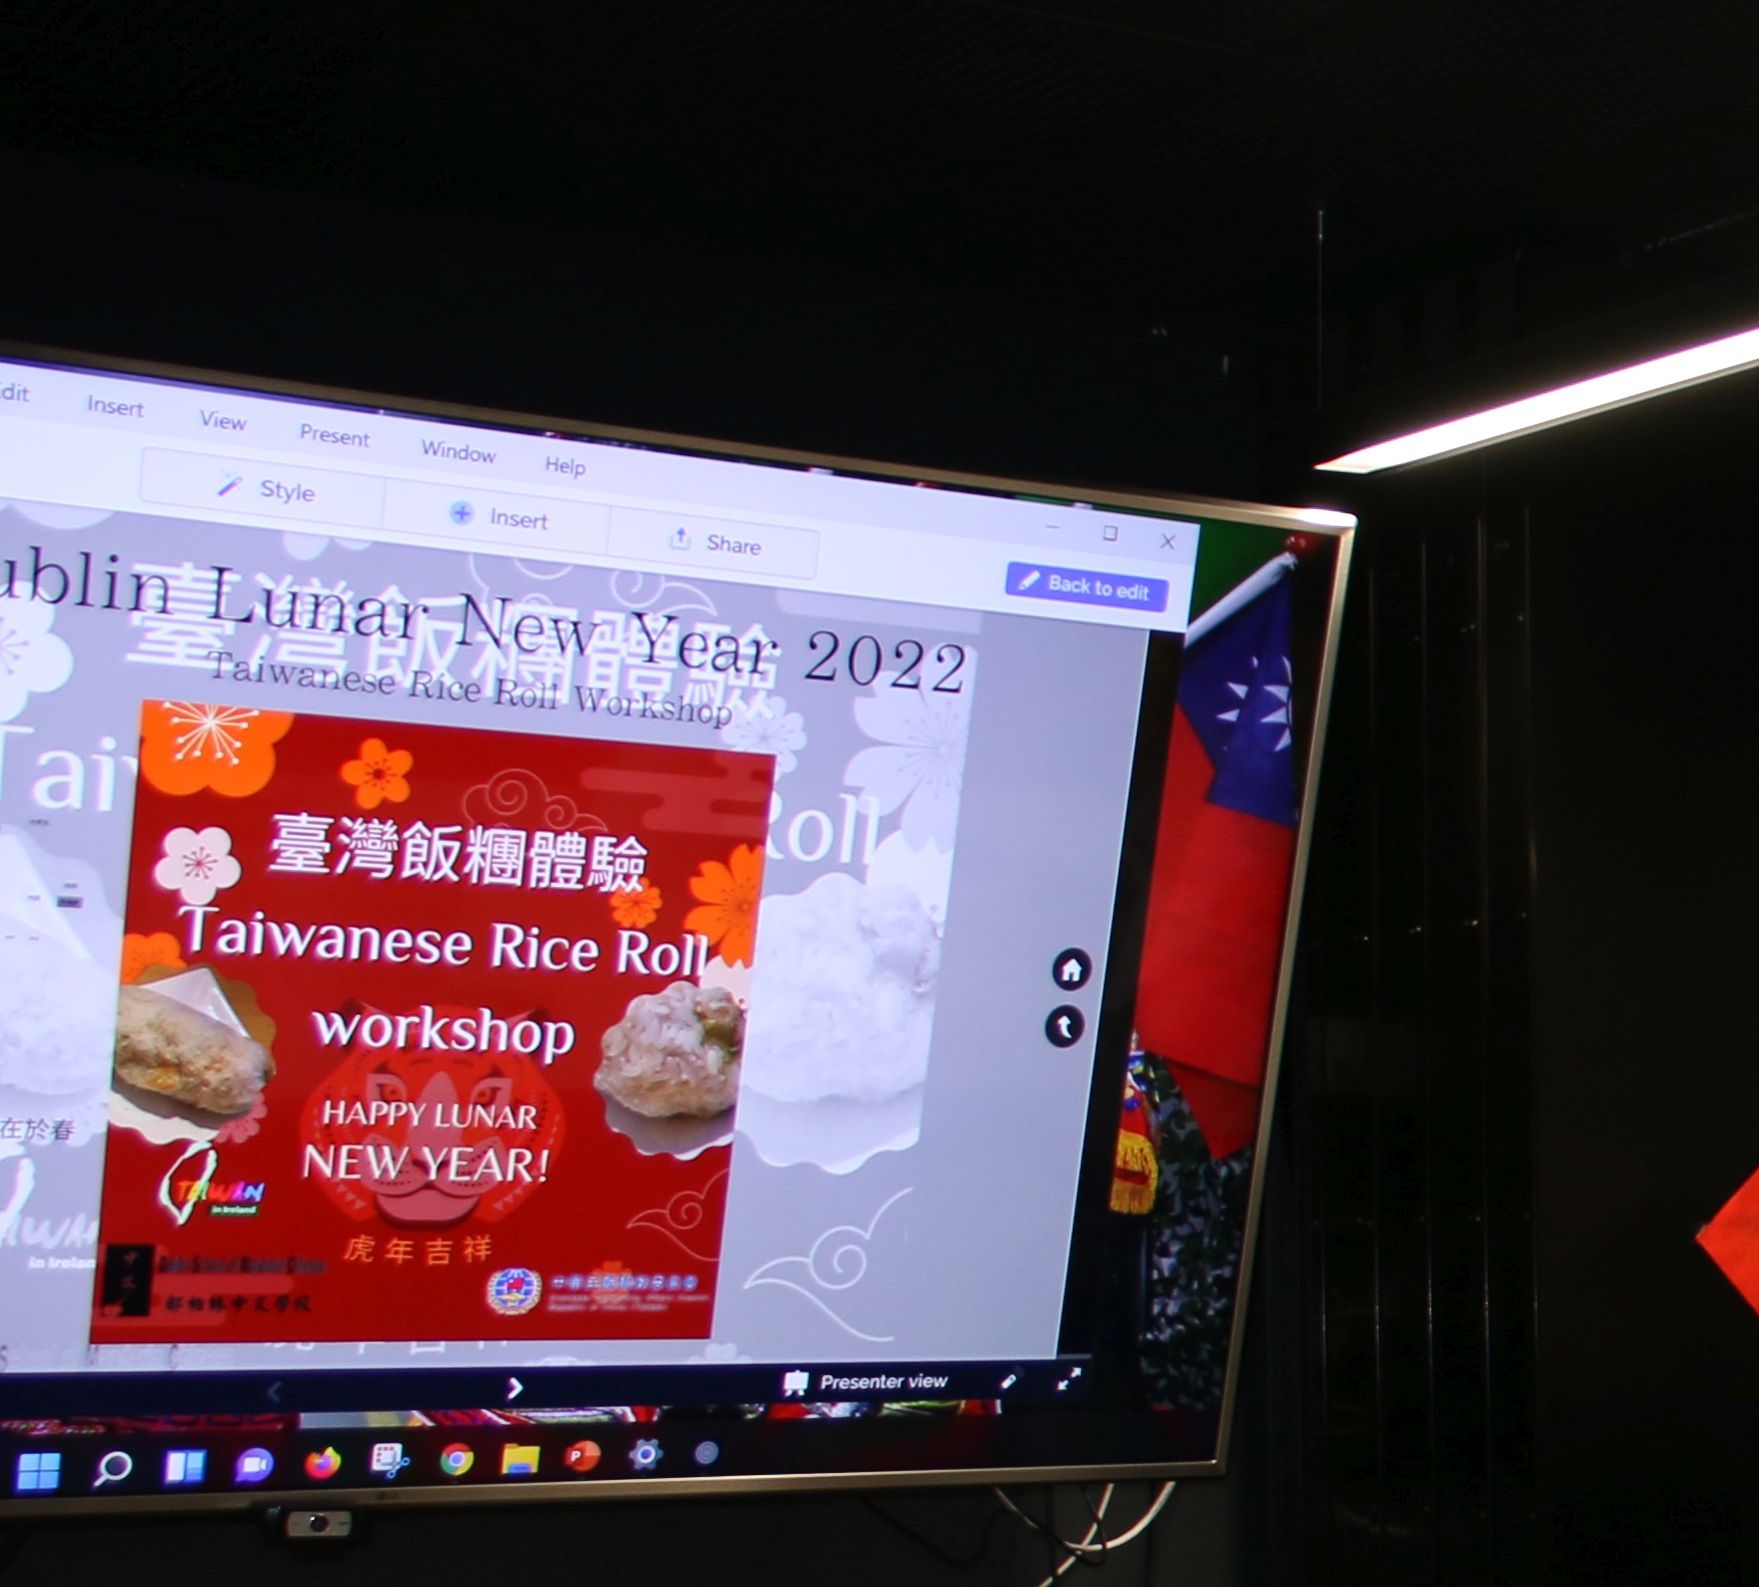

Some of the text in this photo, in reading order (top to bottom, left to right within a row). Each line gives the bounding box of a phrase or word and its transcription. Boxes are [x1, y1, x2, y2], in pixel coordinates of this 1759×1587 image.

[87, 394, 145, 419] Insert
[200, 410, 248, 433] View
[300, 424, 371, 449] Present
[421, 439, 497, 465] Window
[545, 457, 587, 480] Help
[260, 479, 1150, 602] Style Insert Share Back to edit
[207, 566, 428, 643] Lunar
[455, 594, 604, 658] New
[633, 612, 779, 676] Year
[805, 630, 968, 693] 2022
[206, 649, 734, 731] Taiwanese Rice Roll Workshop
[177, 906, 712, 977] Taiwanese Rice Roll
[311, 1004, 576, 1064] workshop
[322, 1099, 538, 1130] HAPPY LUNAR
[177, 1180, 266, 1203] TAIWAN
[303, 1143, 551, 1185] NEW YEAR!
[344, 1234, 494, 1267] 虎年吉祥
[821, 1372, 949, 1390] Presenter view
